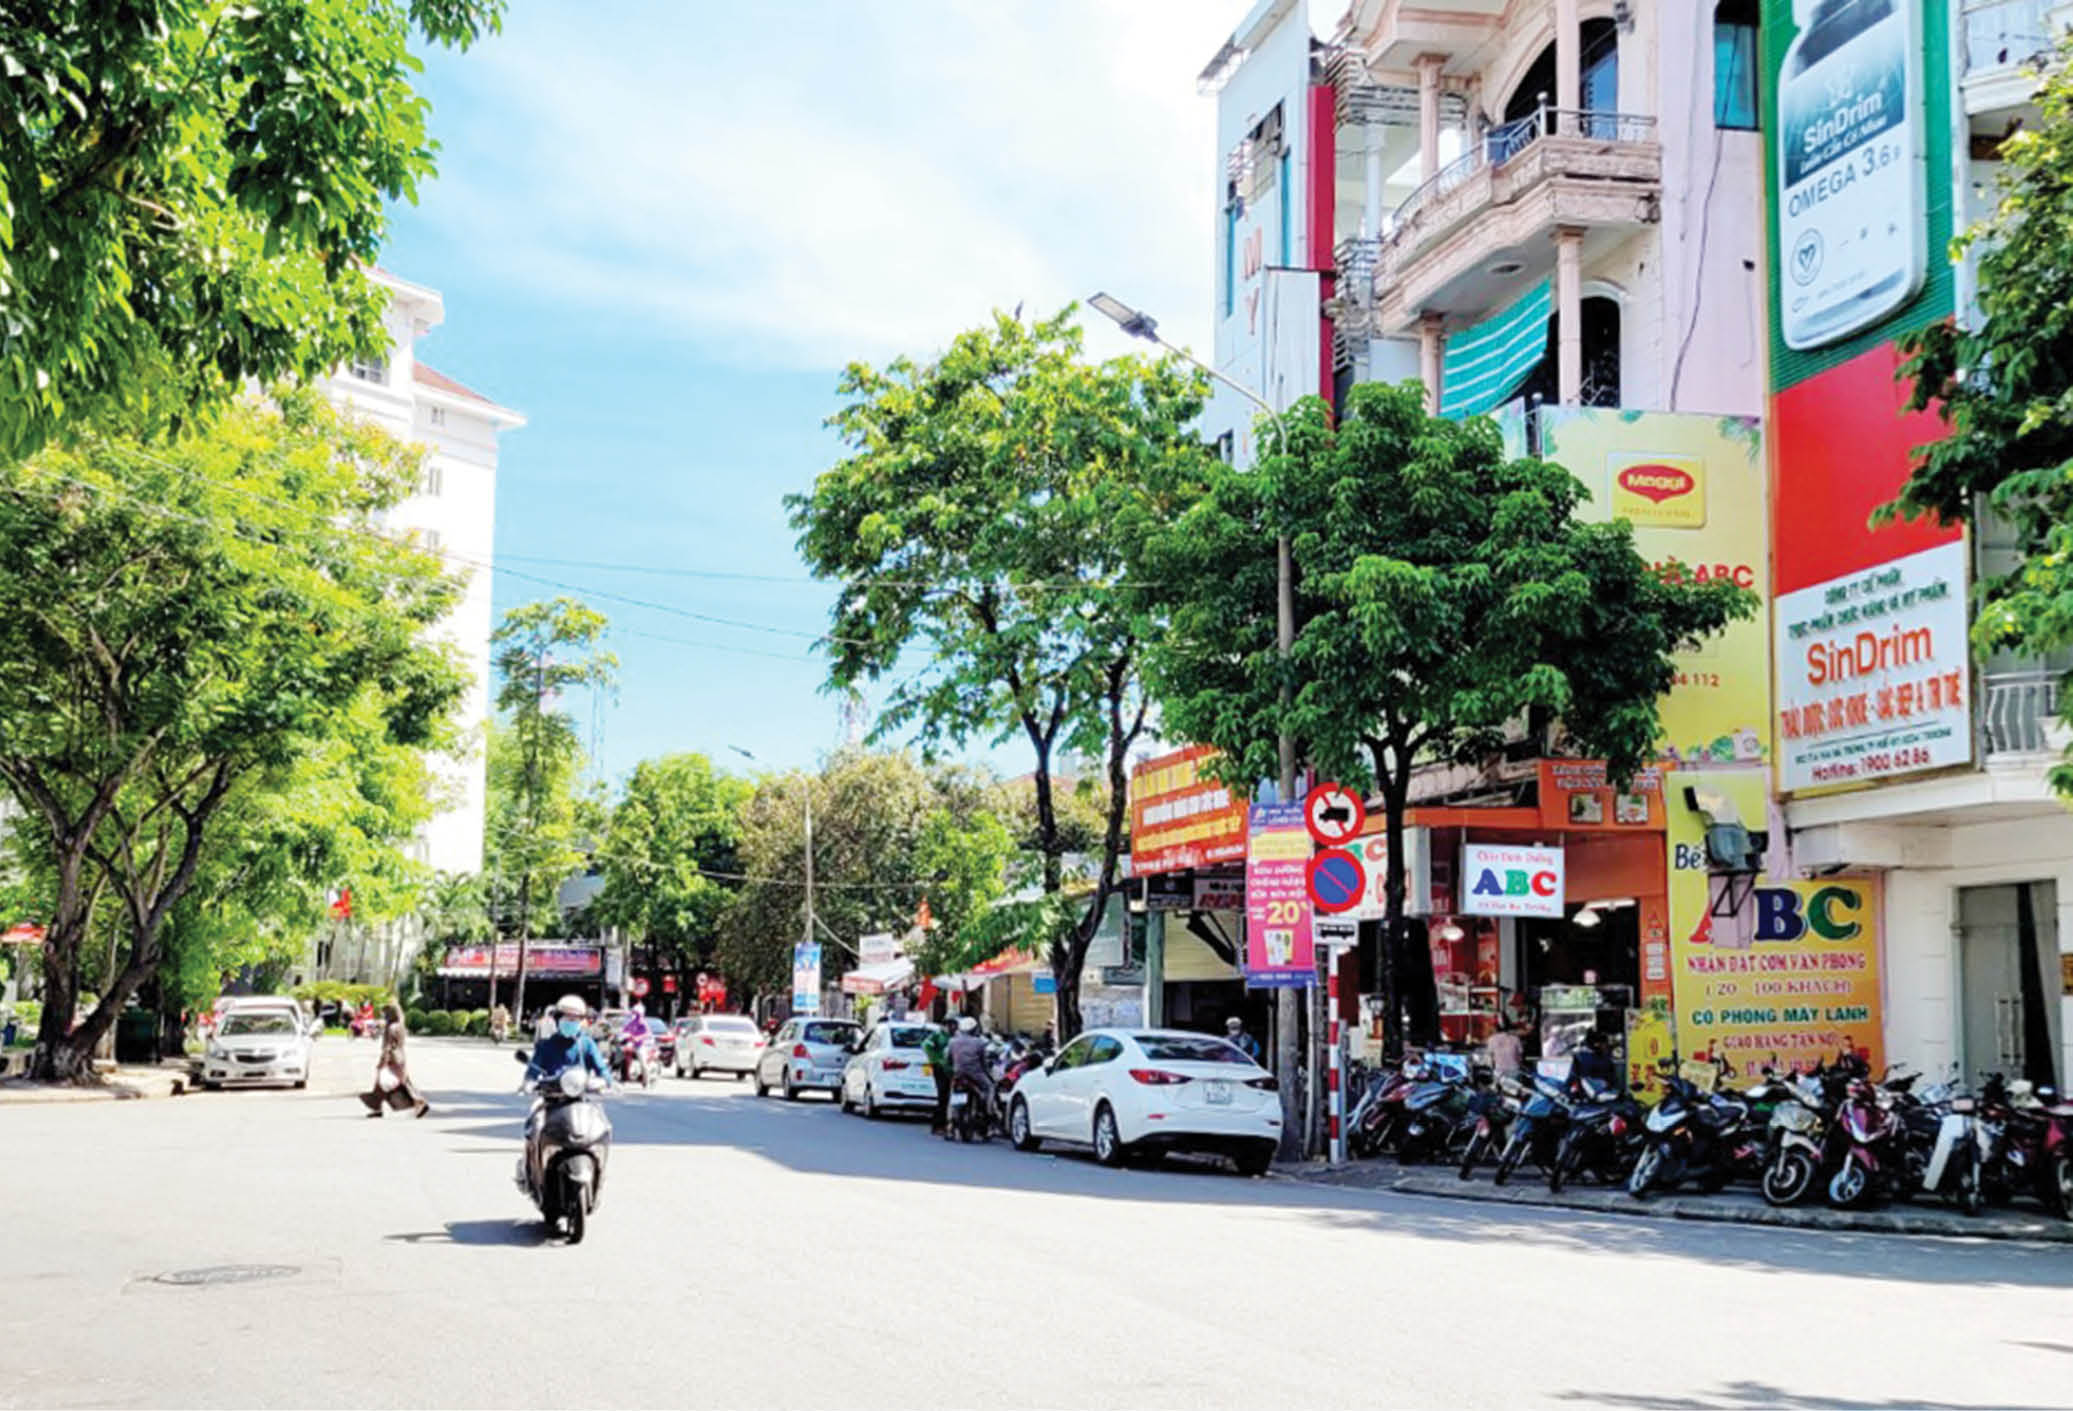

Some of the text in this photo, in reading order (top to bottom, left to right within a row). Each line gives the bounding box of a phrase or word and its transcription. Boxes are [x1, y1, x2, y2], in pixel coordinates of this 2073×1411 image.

[1803, 91, 1883, 154] SinDrim
[1788, 163, 1856, 218] OMEGA
[1807, 623, 1932, 686] SinDrim
[1859, 754, 1891, 773] 1900
[1472, 868, 1557, 897] ABC
